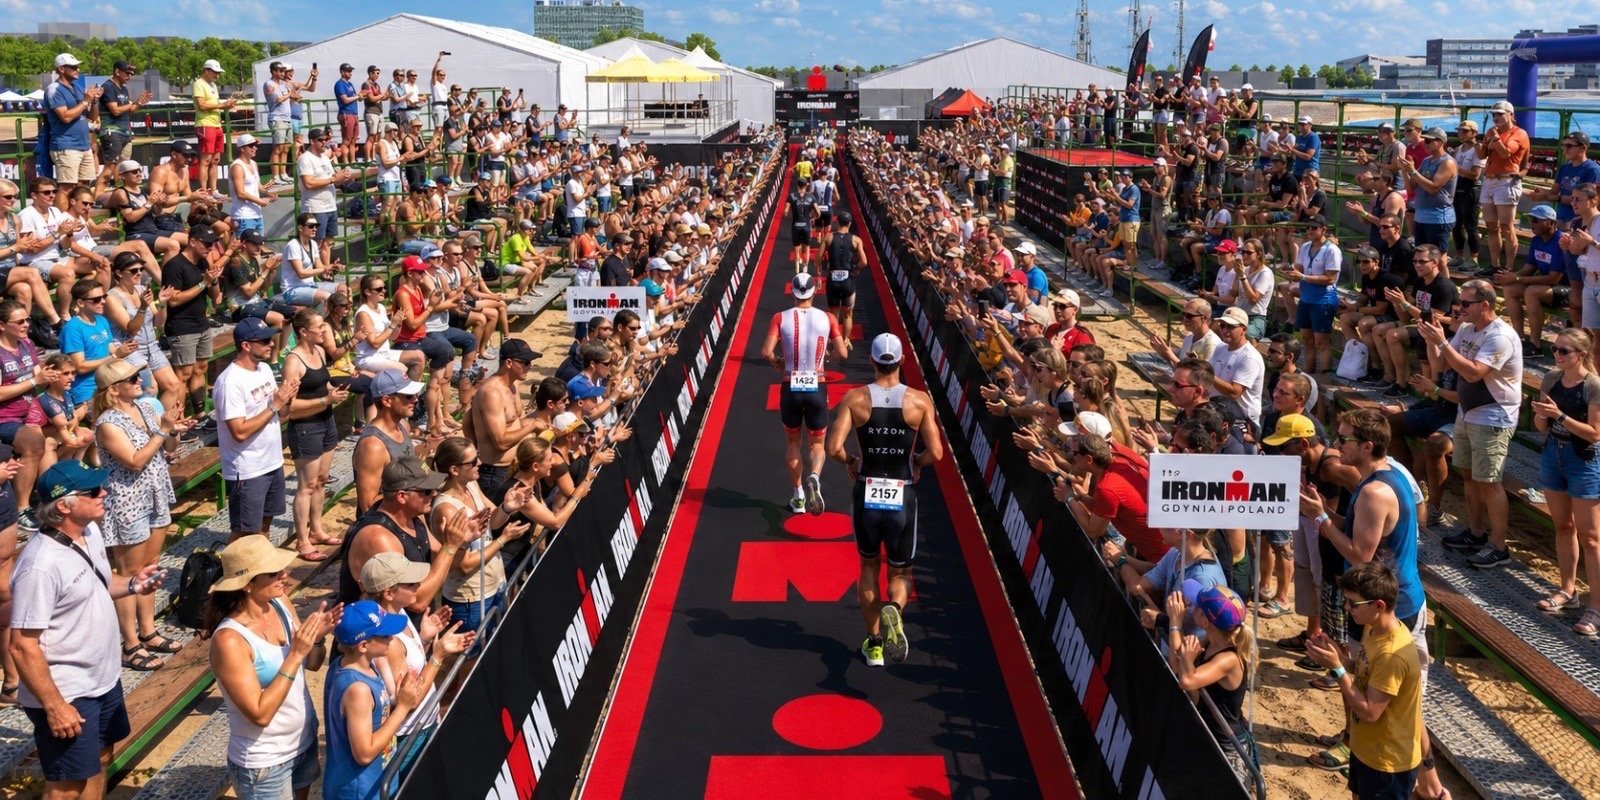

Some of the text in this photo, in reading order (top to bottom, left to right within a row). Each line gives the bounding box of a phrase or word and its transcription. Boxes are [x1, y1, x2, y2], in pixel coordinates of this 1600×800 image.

[797, 99, 837, 109] IRONMAN
[573, 293, 639, 309] IRONMAN
[868, 427, 906, 435] RYZON
[868, 447, 905, 455] RYZON
[870, 487, 898, 499] 2157
[1161, 470, 1287, 502] IRONMAN
[1161, 503, 1286, 514] GDYNIA POLAND
[610, 476, 653, 581] IRONMAN
[1002, 491, 1055, 620] IRONMAN
[552, 562, 615, 709] IRONMAN
[1051, 597, 1133, 790] IRONMAN
